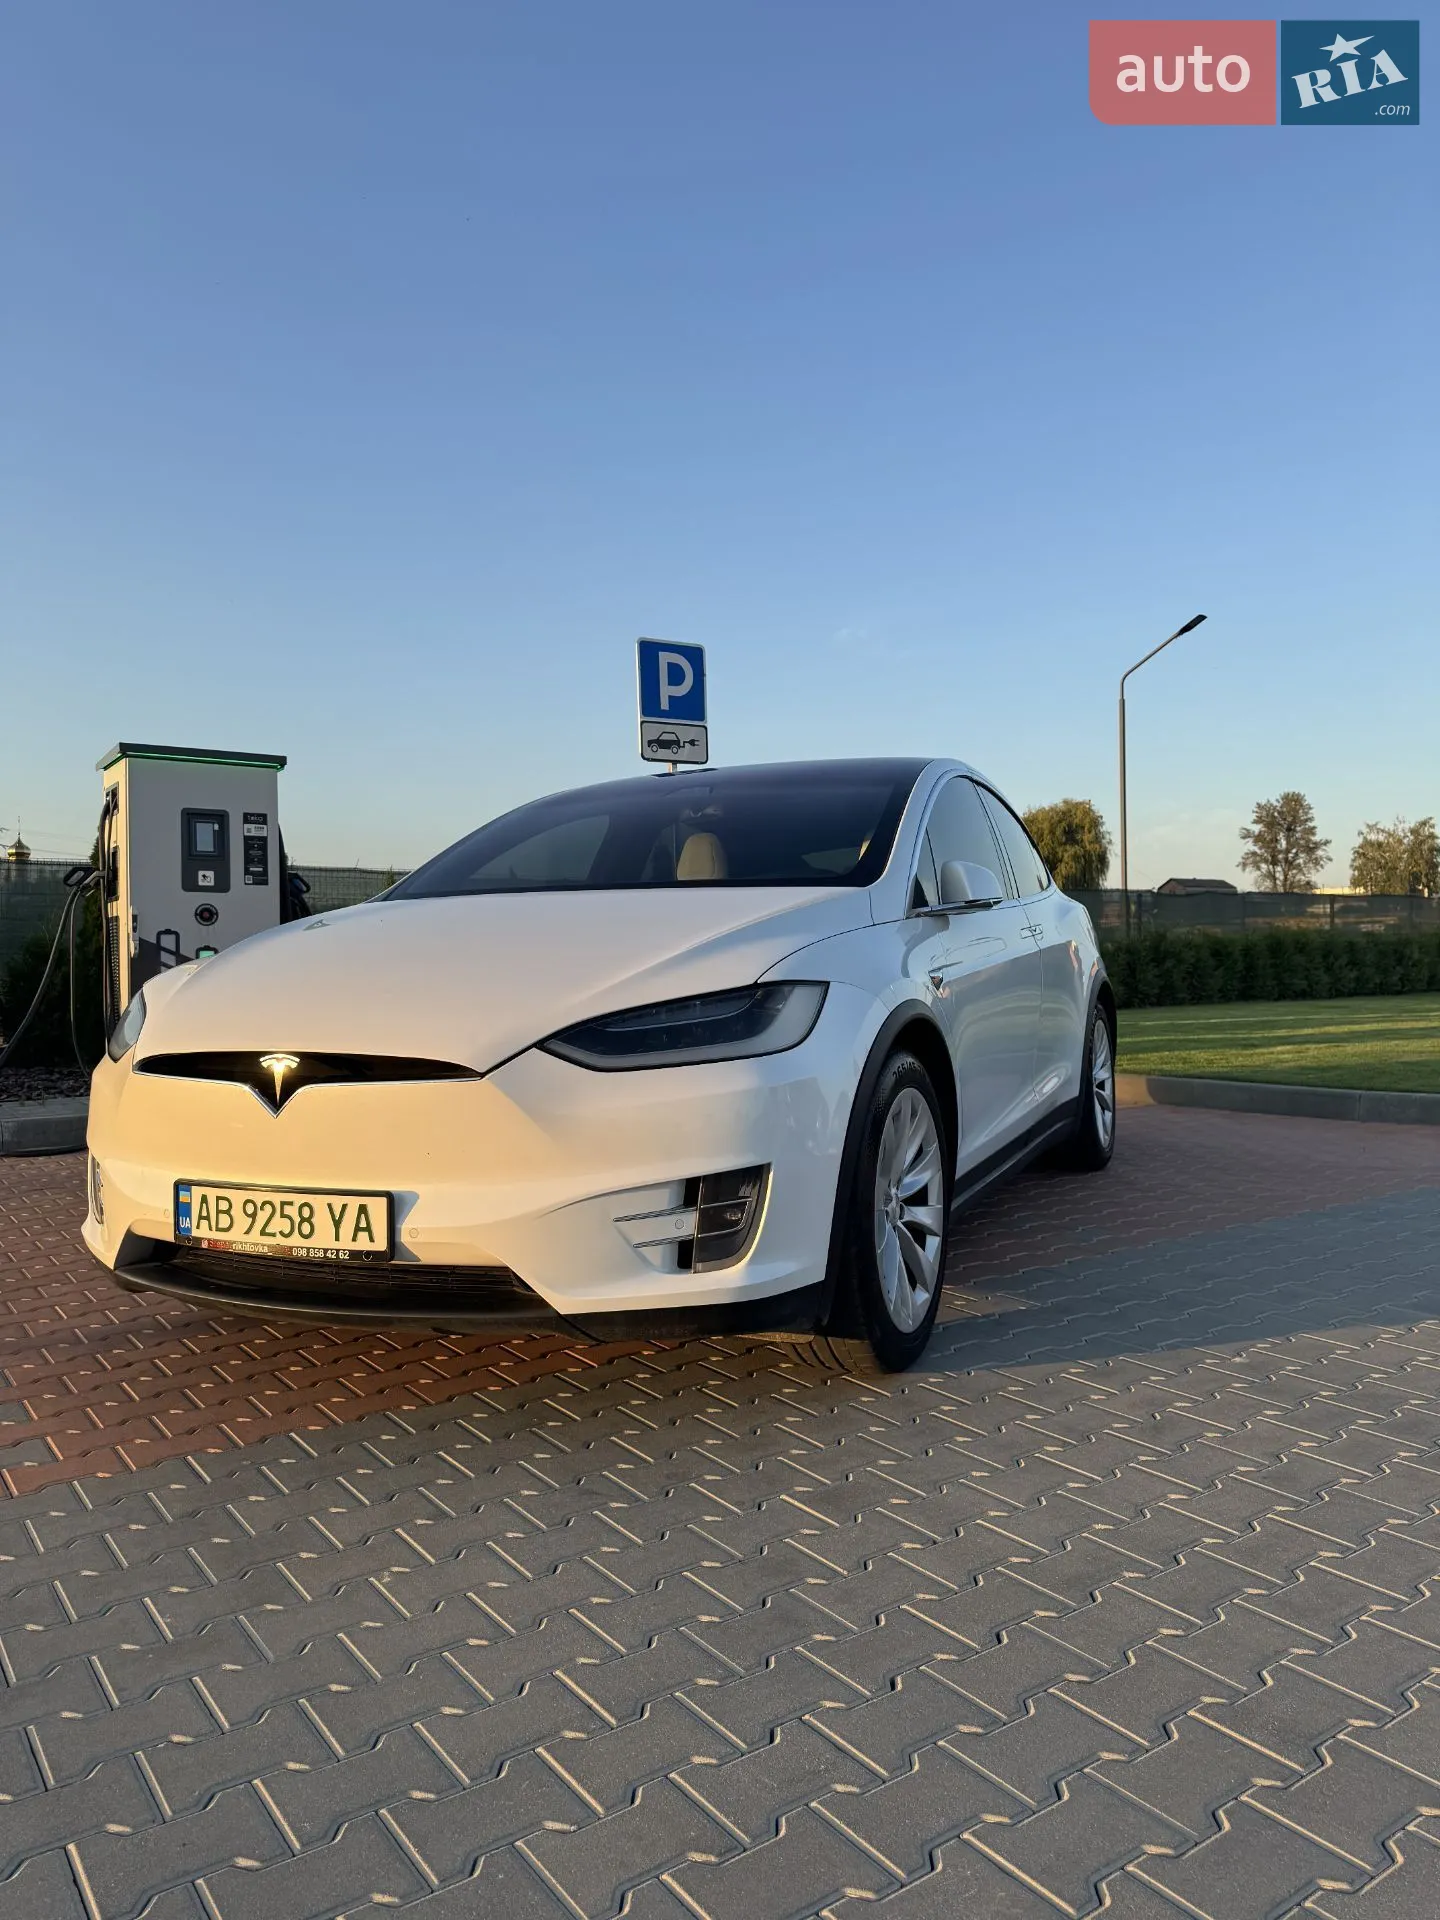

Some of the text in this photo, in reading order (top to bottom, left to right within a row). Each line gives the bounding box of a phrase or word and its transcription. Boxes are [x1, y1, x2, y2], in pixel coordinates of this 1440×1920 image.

[658, 651, 694, 711] P
[179, 1215, 192, 1229] UA
[195, 1193, 376, 1243] AB 9258 YA
[292, 1247, 307, 1257] 098
[309, 1248, 324, 1258] 858
[326, 1249, 337, 1259] 42
[338, 1250, 350, 1259] 62
